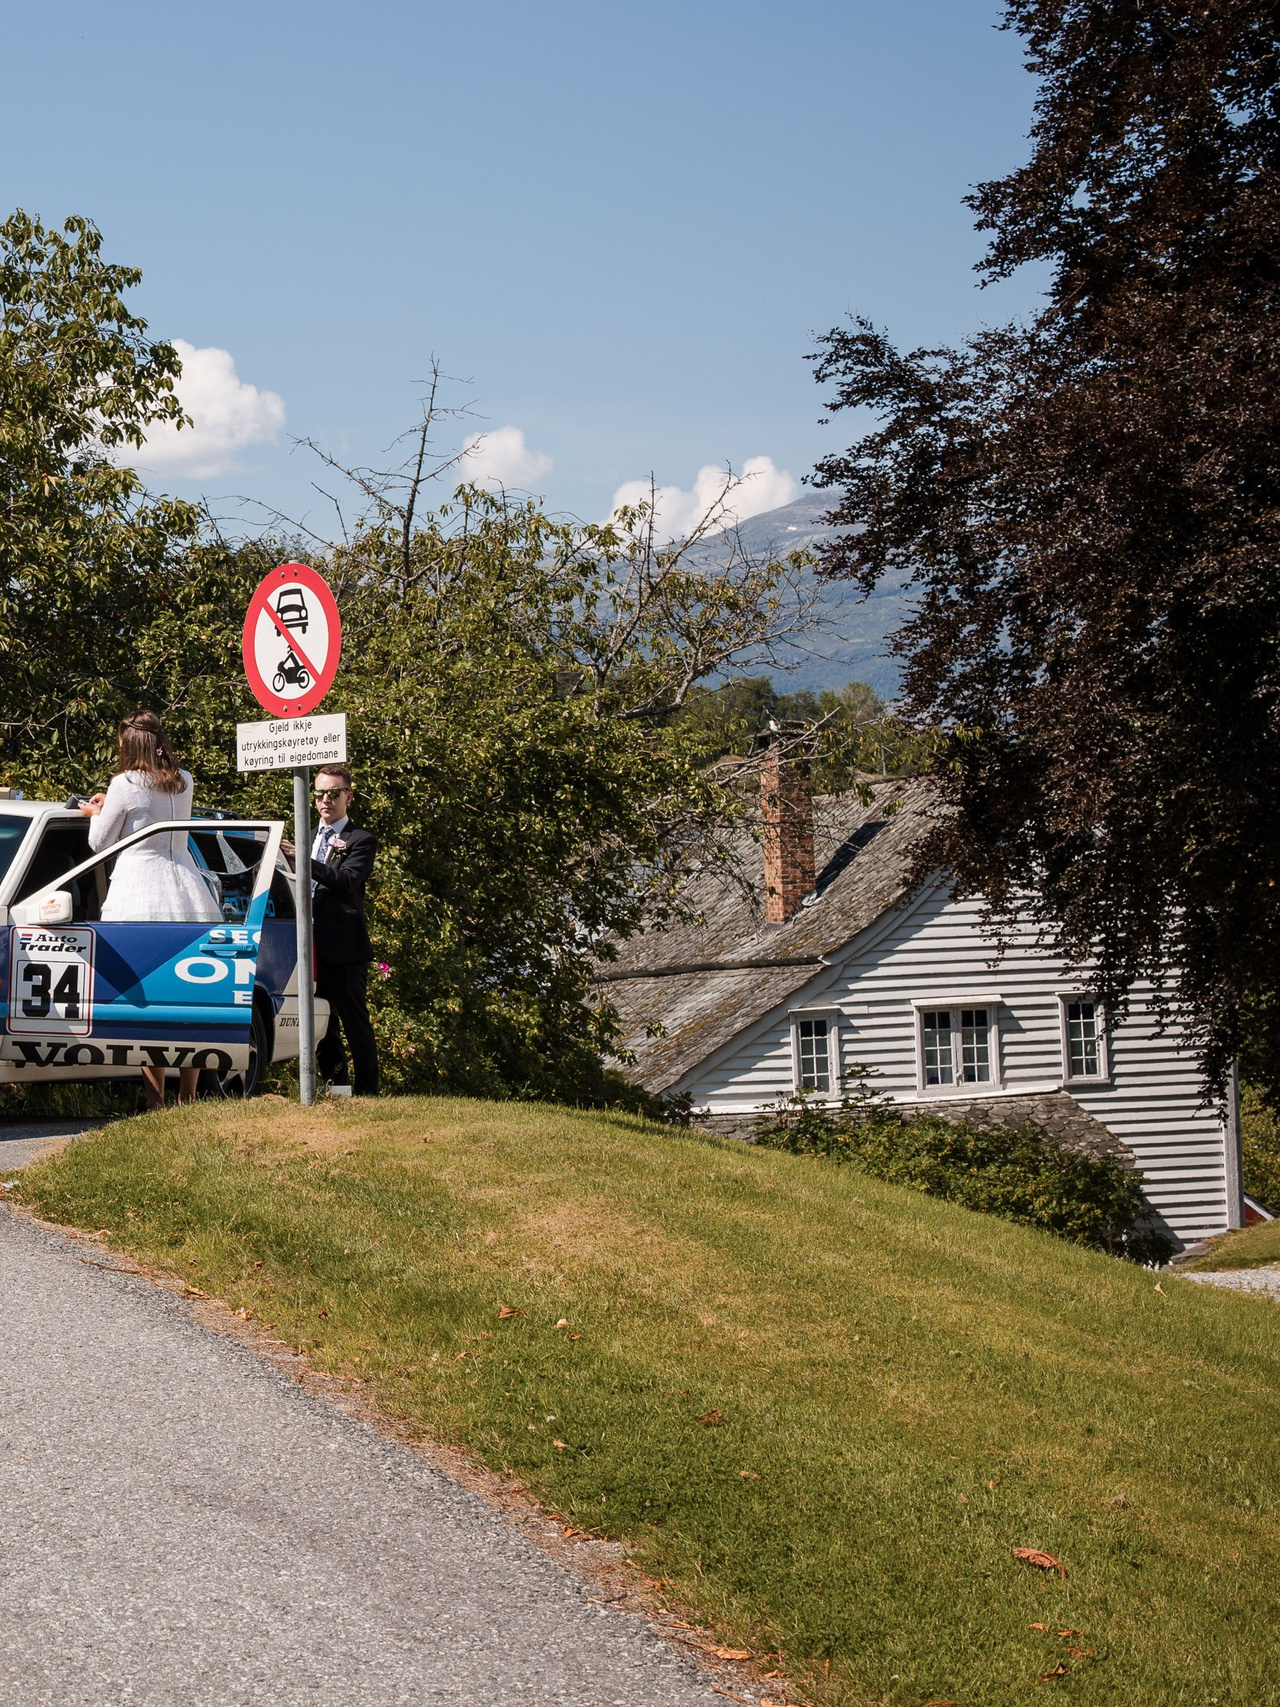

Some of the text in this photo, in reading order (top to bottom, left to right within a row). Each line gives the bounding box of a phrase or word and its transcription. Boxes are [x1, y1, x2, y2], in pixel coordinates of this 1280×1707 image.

[268, 720, 312, 735] Gjeld ikkje
[241, 733, 340, 752] utrykkingskøyretøy eller
[244, 750, 339, 768] køyring til eigedomane
[19, 941, 87, 953] Trader
[34, 933, 78, 944] Auto
[22, 963, 81, 1019] 34
[11, 1040, 238, 1071] VOLVO
